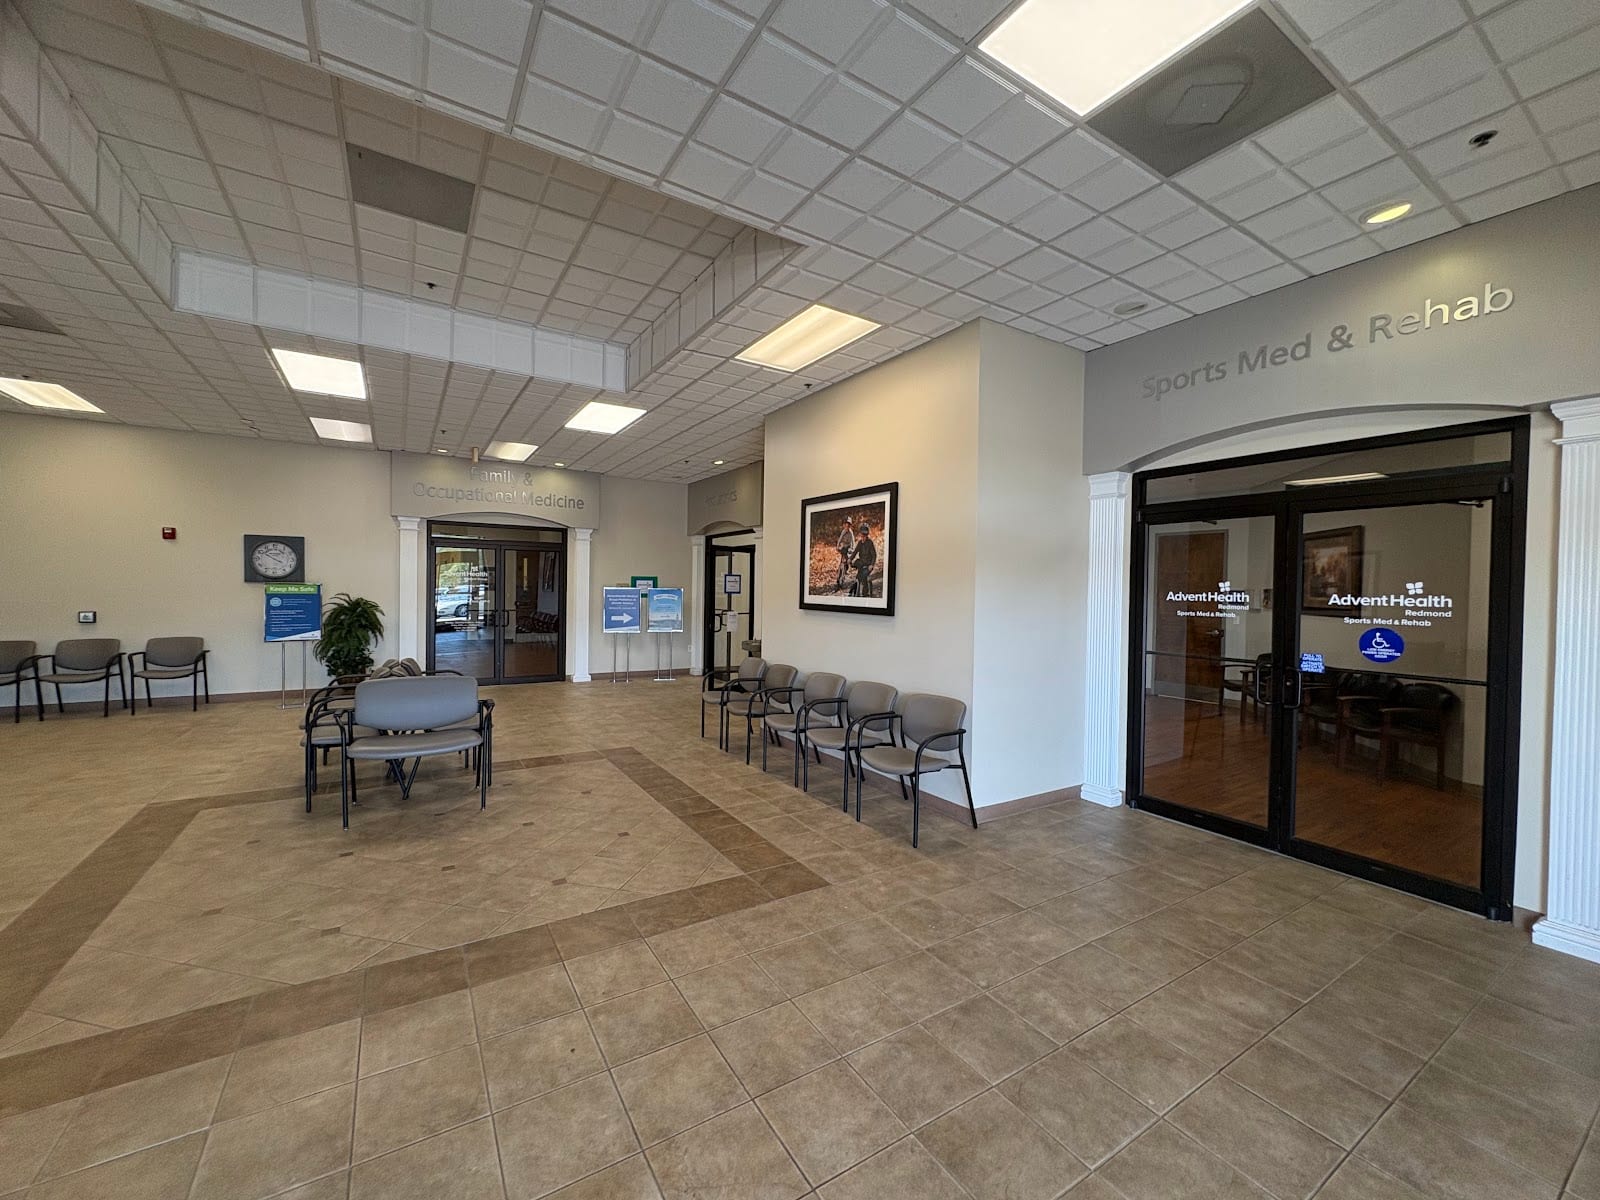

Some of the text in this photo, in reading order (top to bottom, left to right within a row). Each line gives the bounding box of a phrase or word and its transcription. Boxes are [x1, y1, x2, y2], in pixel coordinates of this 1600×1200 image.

[1142, 283, 1514, 401] Sports Med & Rehab
[523, 472, 533, 486] &
[412, 482, 585, 510] Occupational Medicine
[1166, 592, 1250, 602] AdventHealth
[1328, 593, 1453, 608] AdventHealth
[1405, 609, 1452, 618] Redmond
[1343, 617, 1371, 625] Sports
[1401, 619, 1431, 627] Rehab
